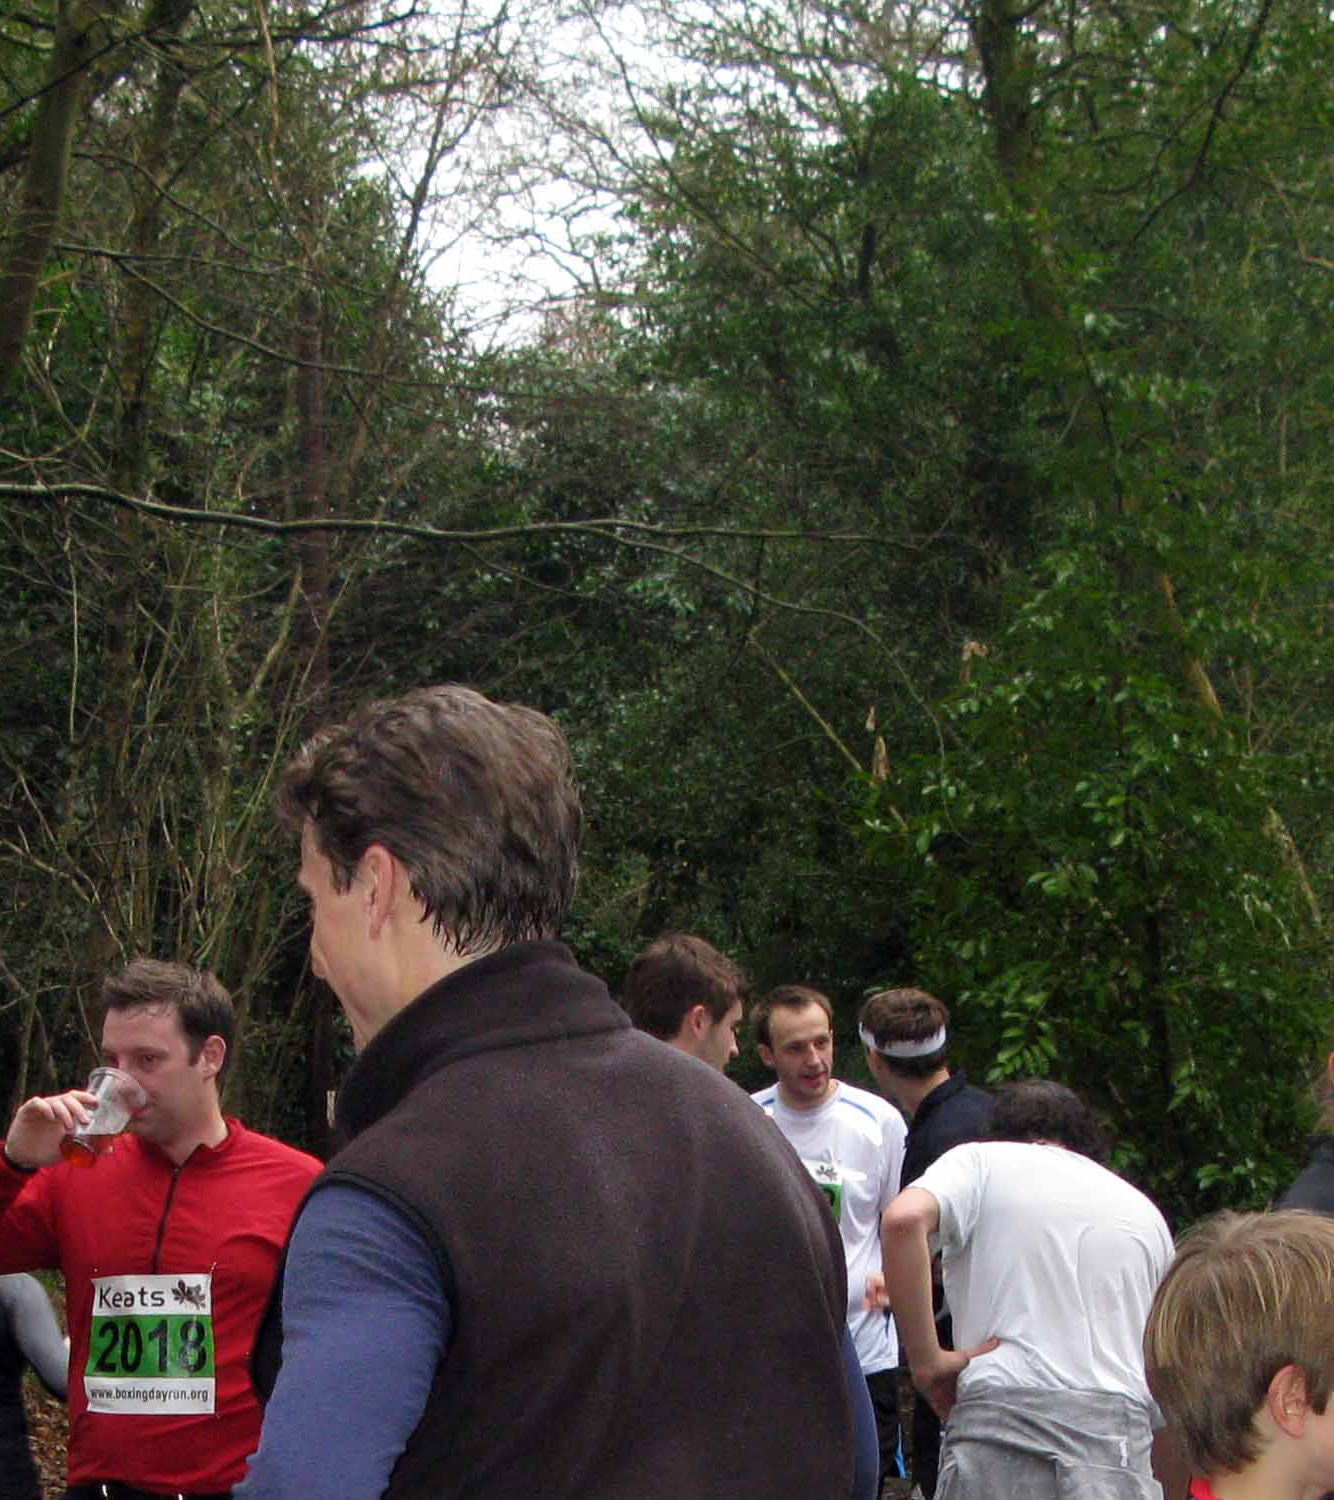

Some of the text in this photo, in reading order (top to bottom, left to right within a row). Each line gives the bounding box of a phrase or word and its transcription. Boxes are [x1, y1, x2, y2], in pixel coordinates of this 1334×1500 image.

[98, 1286, 166, 1310] Keats
[94, 1320, 207, 1373] 2018
[90, 1387, 209, 1402] www.boxingdayrun.org
